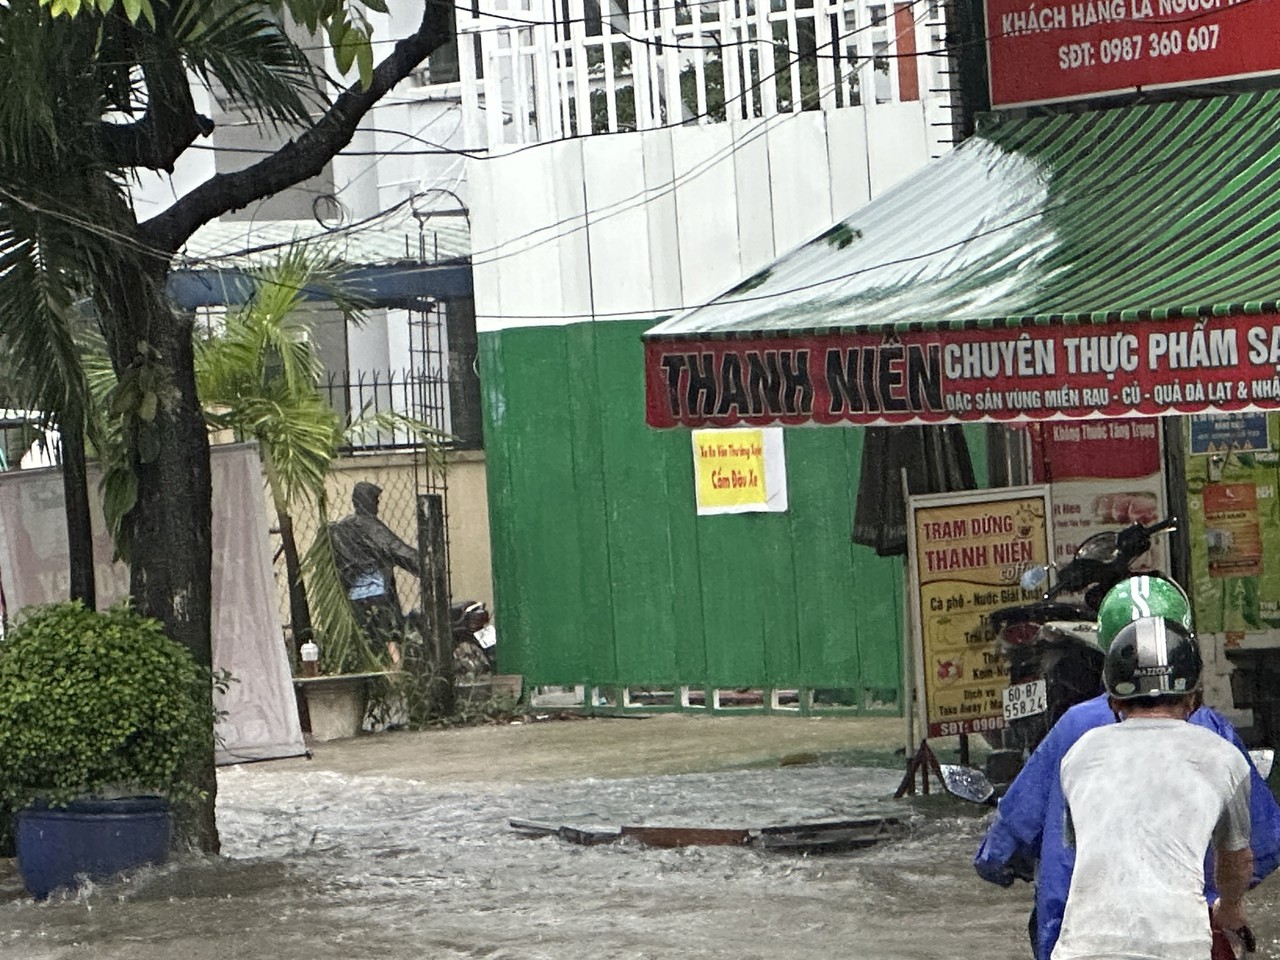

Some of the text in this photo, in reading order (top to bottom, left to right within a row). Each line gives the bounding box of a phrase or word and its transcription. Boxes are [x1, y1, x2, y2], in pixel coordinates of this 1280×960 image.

[1002, 3, 1067, 37] KHÁCH
[1058, 24, 1220, 69] SĐT: 0987 360 607
[944, 333, 1056, 379] CHUYÊN
[1063, 331, 1139, 380] THỰC
[1149, 318, 1239, 370] PHẨM
[660, 333, 946, 418] THANH NIÊN
[946, 391, 972, 414] ĐẶC
[975, 387, 1003, 409] SẢN
[1005, 388, 1041, 409] VÙNG
[1083, 388, 1109, 406] RAU
[1122, 381, 1141, 404] CỦ
[1154, 379, 1183, 405] QUẢ
[1185, 379, 1205, 402] ĐÀ
[1208, 382, 1233, 404] LẠT
[1237, 381, 1248, 399] &
[925, 545, 988, 572] THANH
[992, 538, 1033, 565] NIÊN
